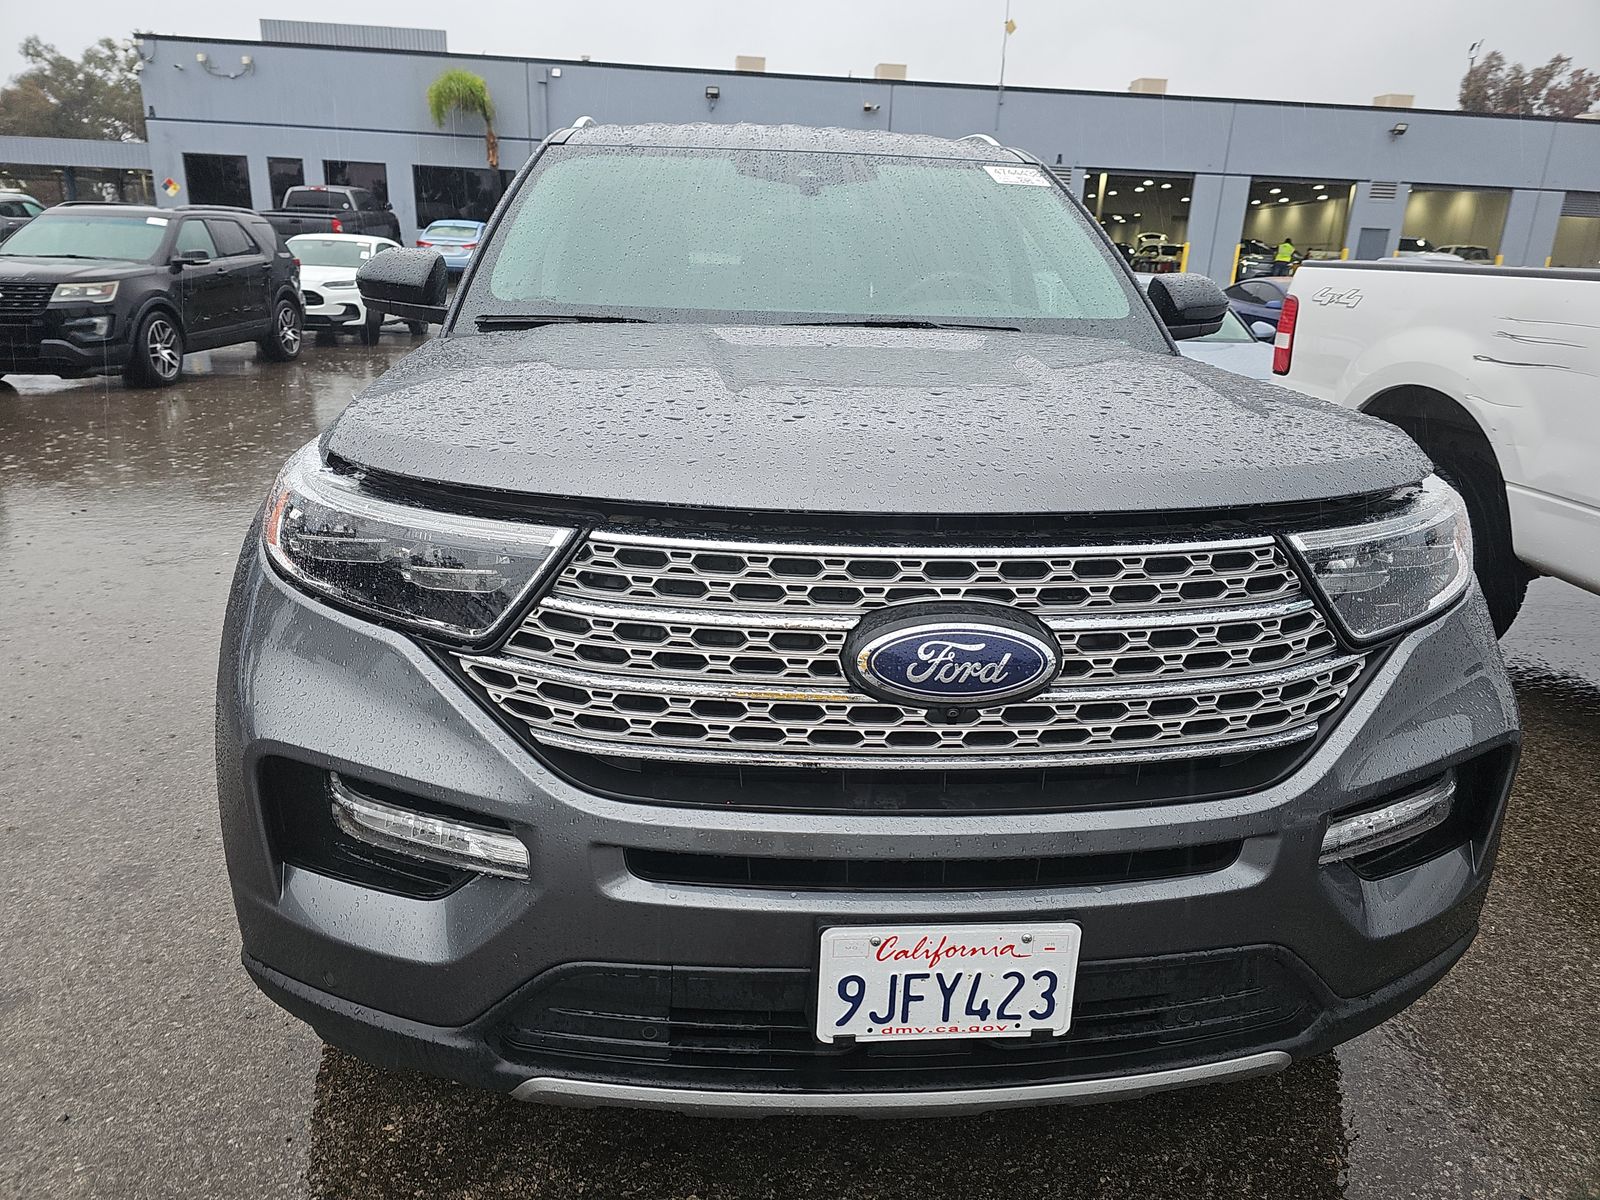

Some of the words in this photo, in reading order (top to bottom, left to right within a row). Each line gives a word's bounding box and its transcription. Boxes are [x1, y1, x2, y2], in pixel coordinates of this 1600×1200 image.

[1312, 286, 1363, 308] 4x4
[906, 640, 1012, 684] Ford
[875, 935, 1032, 968] California
[835, 970, 1058, 1027] 9JFY423
[881, 1025, 1008, 1035] dmv.ca.gov
